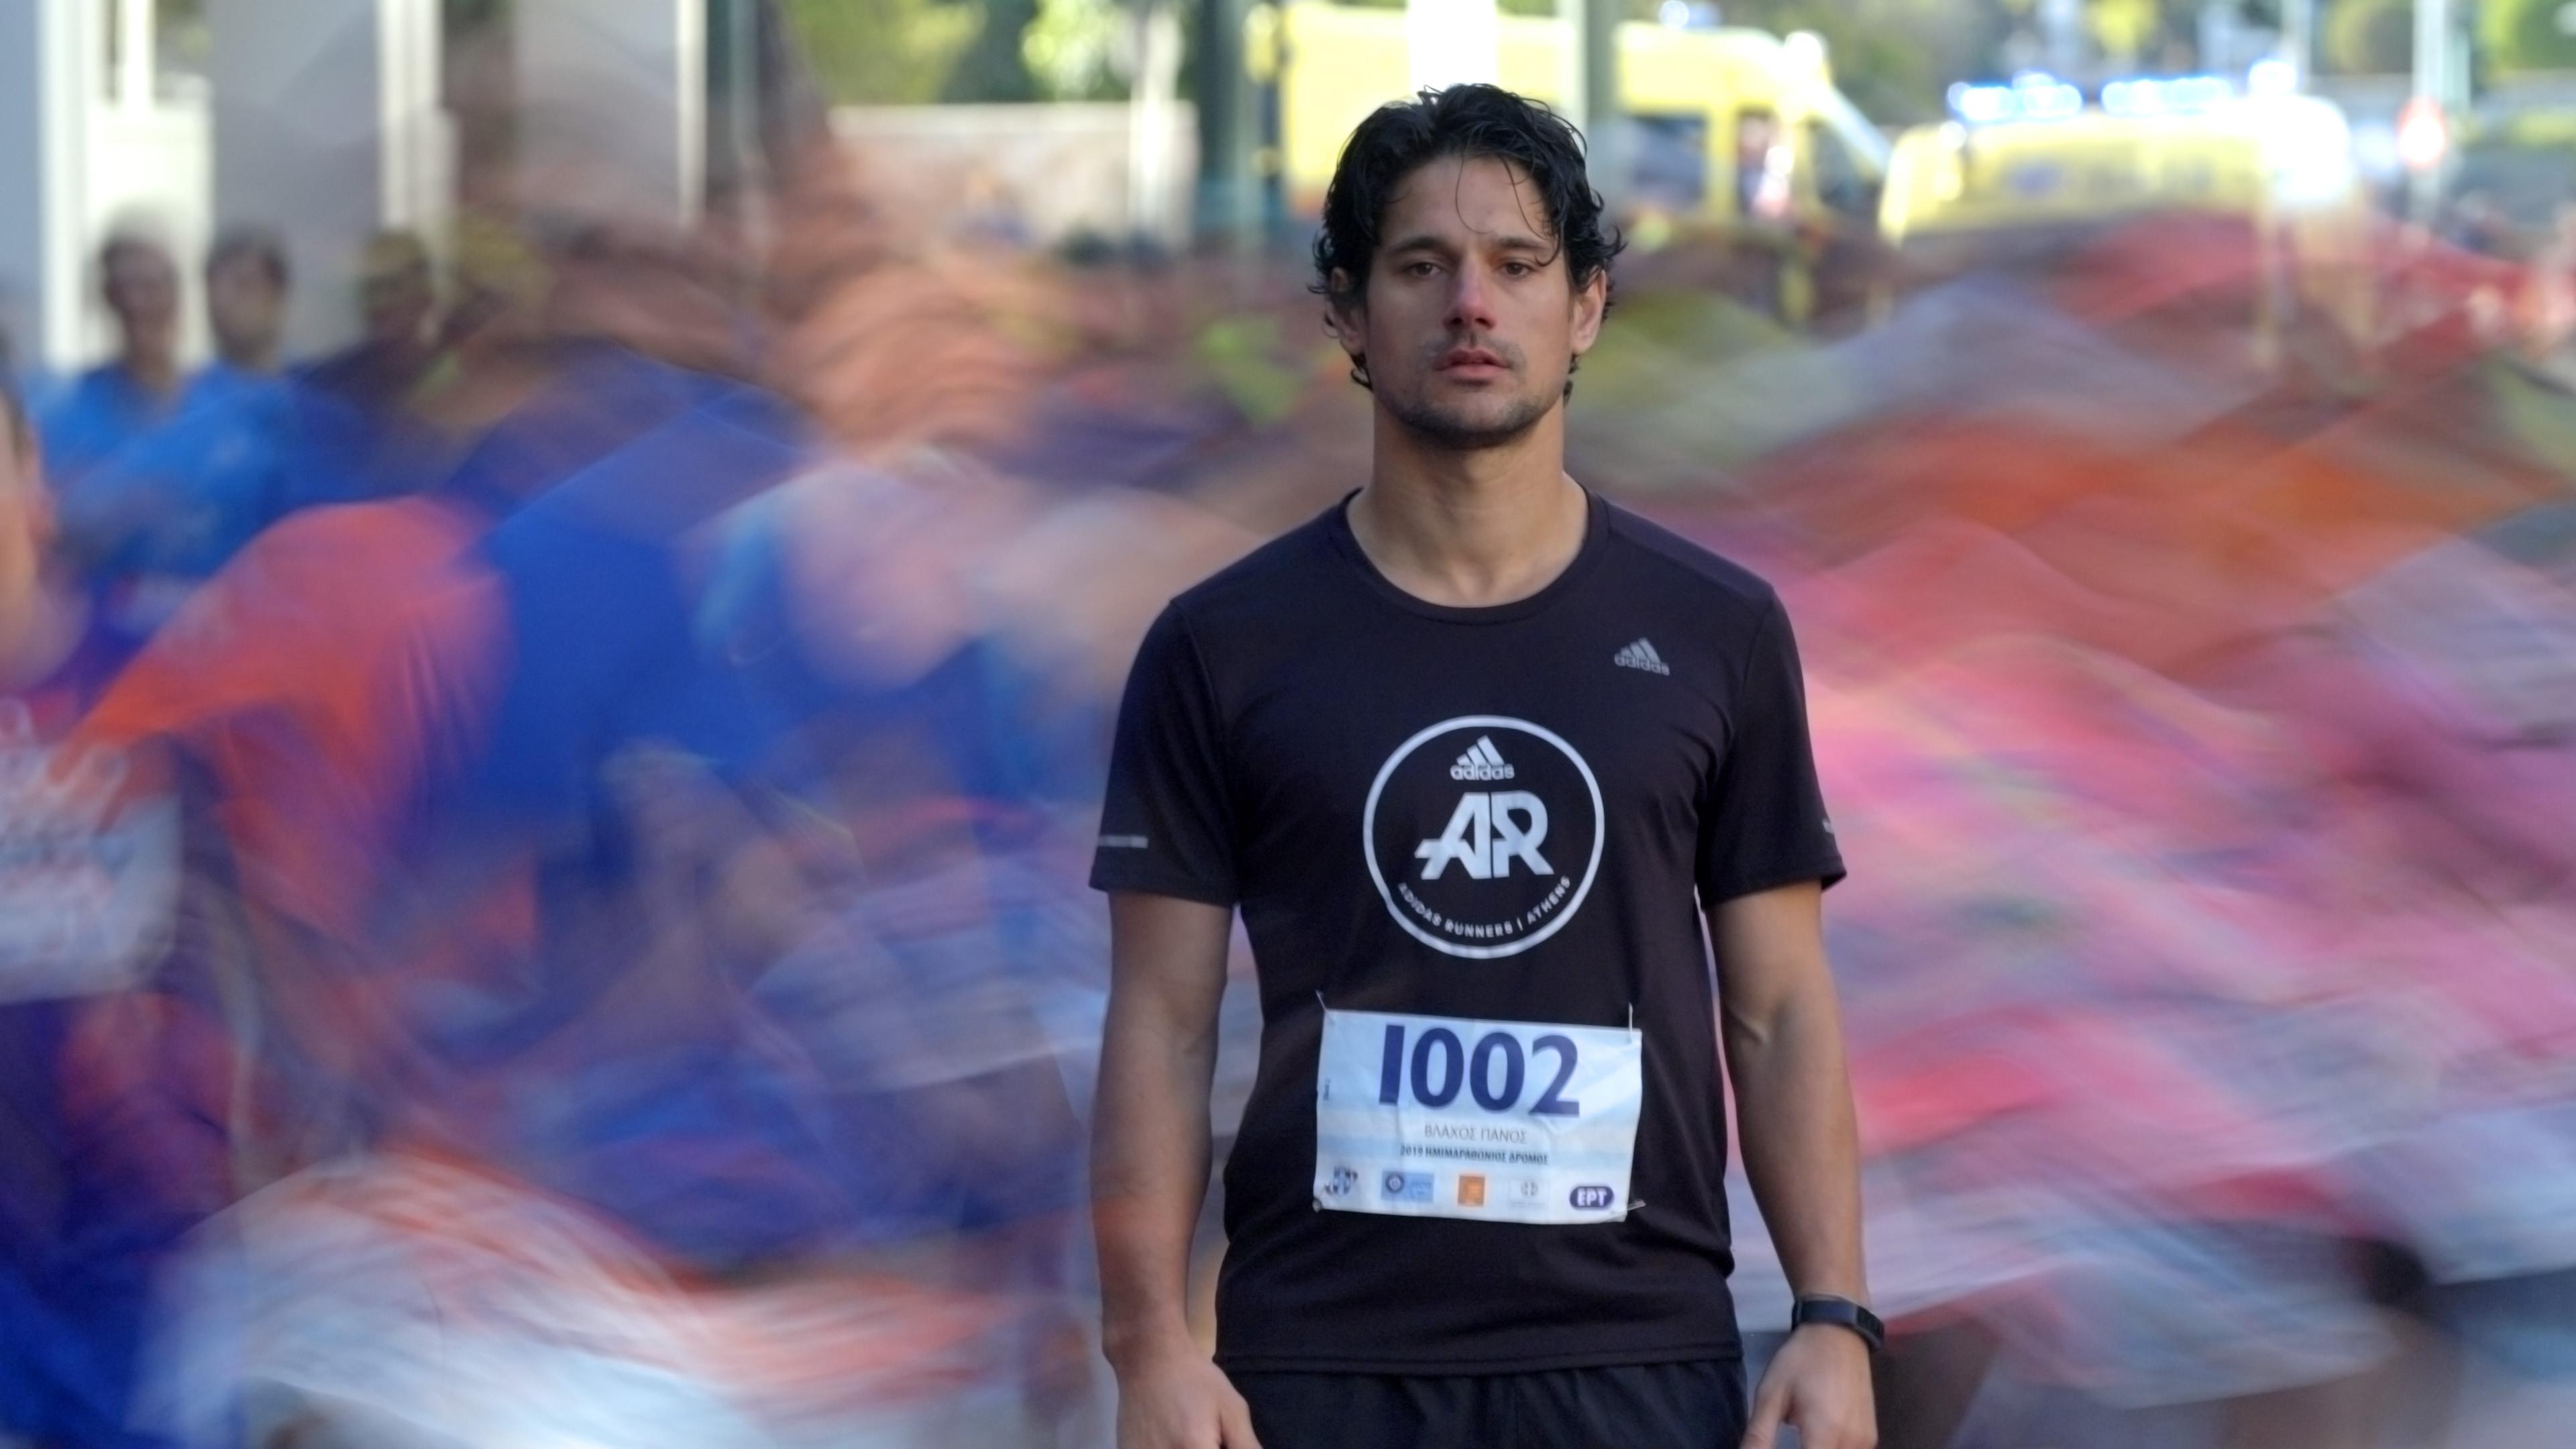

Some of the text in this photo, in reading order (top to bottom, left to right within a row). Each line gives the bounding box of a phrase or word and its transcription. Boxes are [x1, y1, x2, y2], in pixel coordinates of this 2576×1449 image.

[1614, 653, 1670, 676] adidas
[1450, 763, 1515, 780] adidas
[1414, 790, 1554, 879] AR
[1398, 882, 1442, 926] ADIDAS
[1444, 918, 1513, 938] RUNNERS
[1527, 875, 1570, 925] ATHENS
[1379, 1024, 1580, 1118] 1002
[1424, 1124, 1527, 1144] ΒΛΑΧΟΣ ΠΑΝΟΣ
[1399, 1144, 1423, 1158] 2019
[1509, 1150, 1549, 1165] ΔΡΟΜΟΣ
